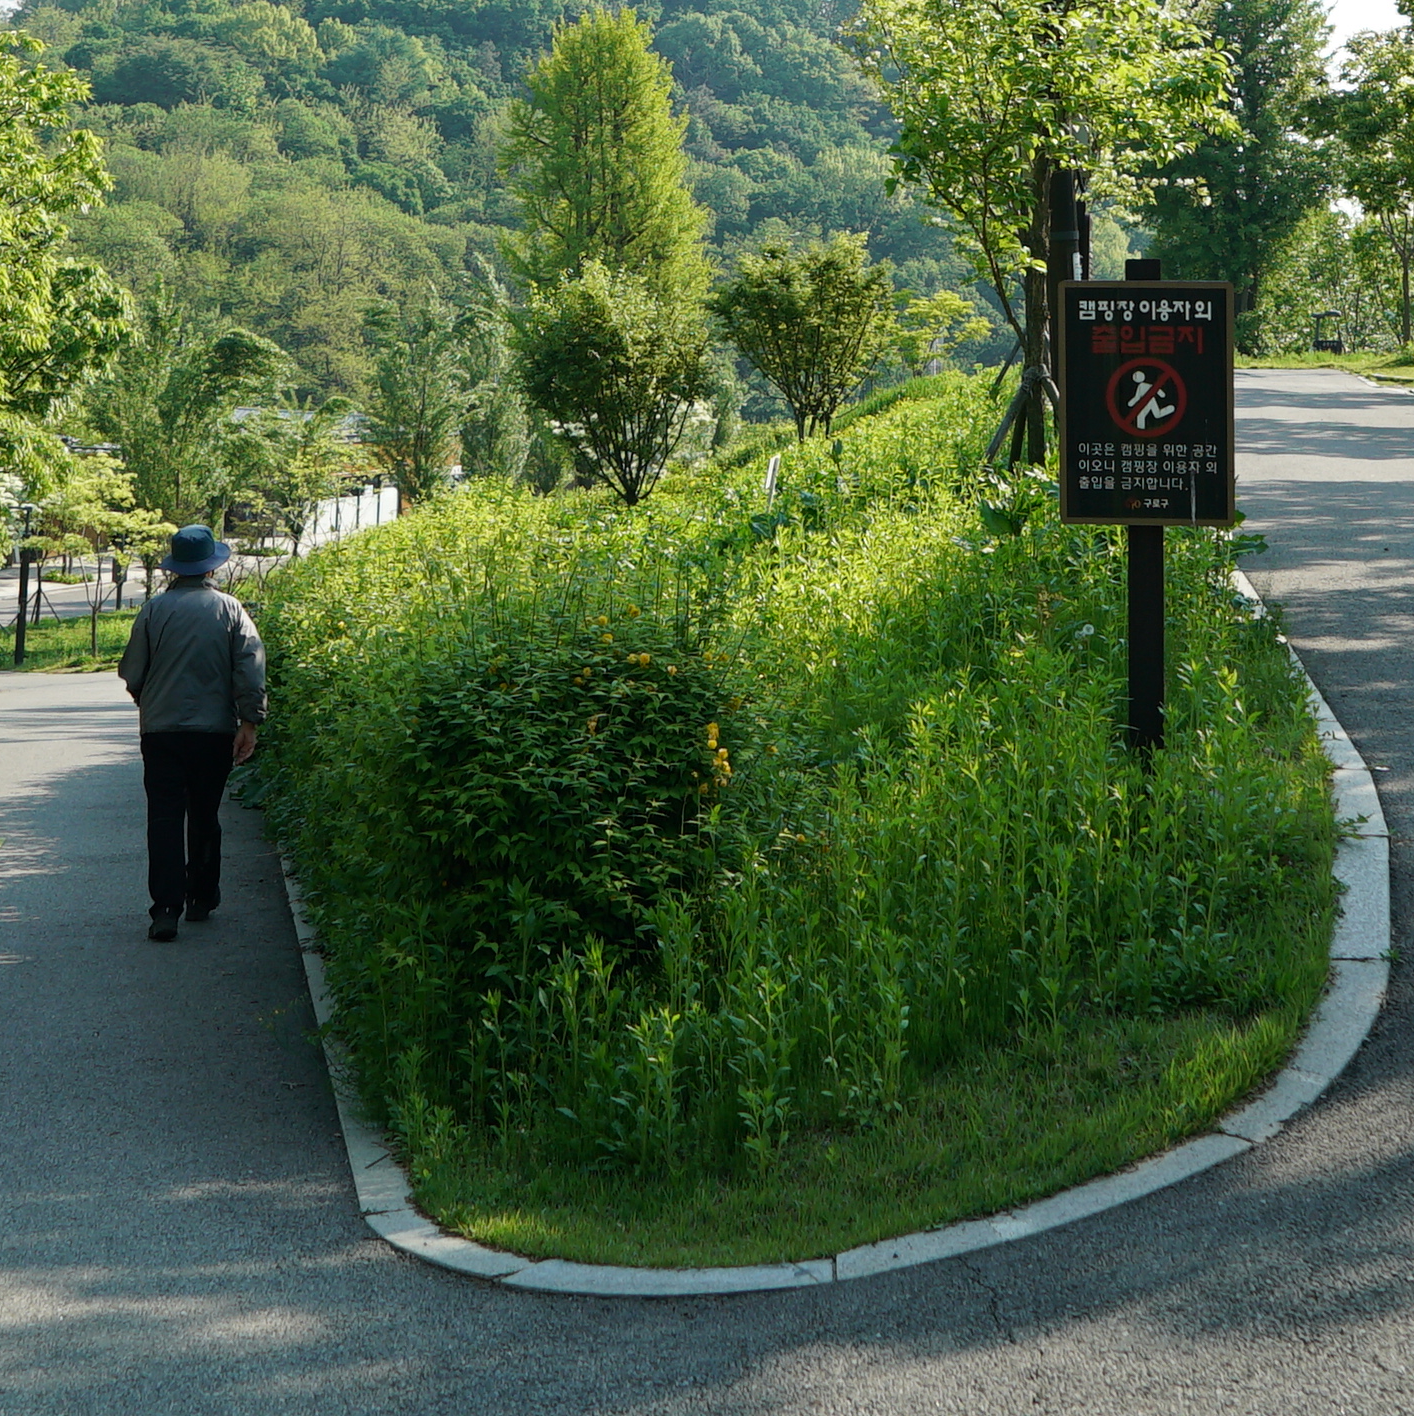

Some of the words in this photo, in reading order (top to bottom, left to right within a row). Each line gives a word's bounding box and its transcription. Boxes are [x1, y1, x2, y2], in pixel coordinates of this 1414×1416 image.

[1079, 300, 1135, 321] 캠핑장
[1139, 299, 1191, 321] 이용자
[1194, 301, 1212, 321] 외
[1091, 324, 1203, 354] 출입금지
[1078, 442, 1115, 457] 이곳은
[1120, 443, 1158, 457] 캠핑을
[1162, 443, 1187, 457] 위한
[1192, 444, 1217, 458] 공간
[1078, 459, 1115, 473] 이오니
[1120, 459, 1158, 474] 캠핑장
[1162, 460, 1200, 474] 이용자
[1205, 461, 1217, 474] 외
[1078, 475, 1115, 490] 출입을
[1120, 476, 1189, 491] 금지합니다.
[1143, 497, 1170, 509] 구로구
